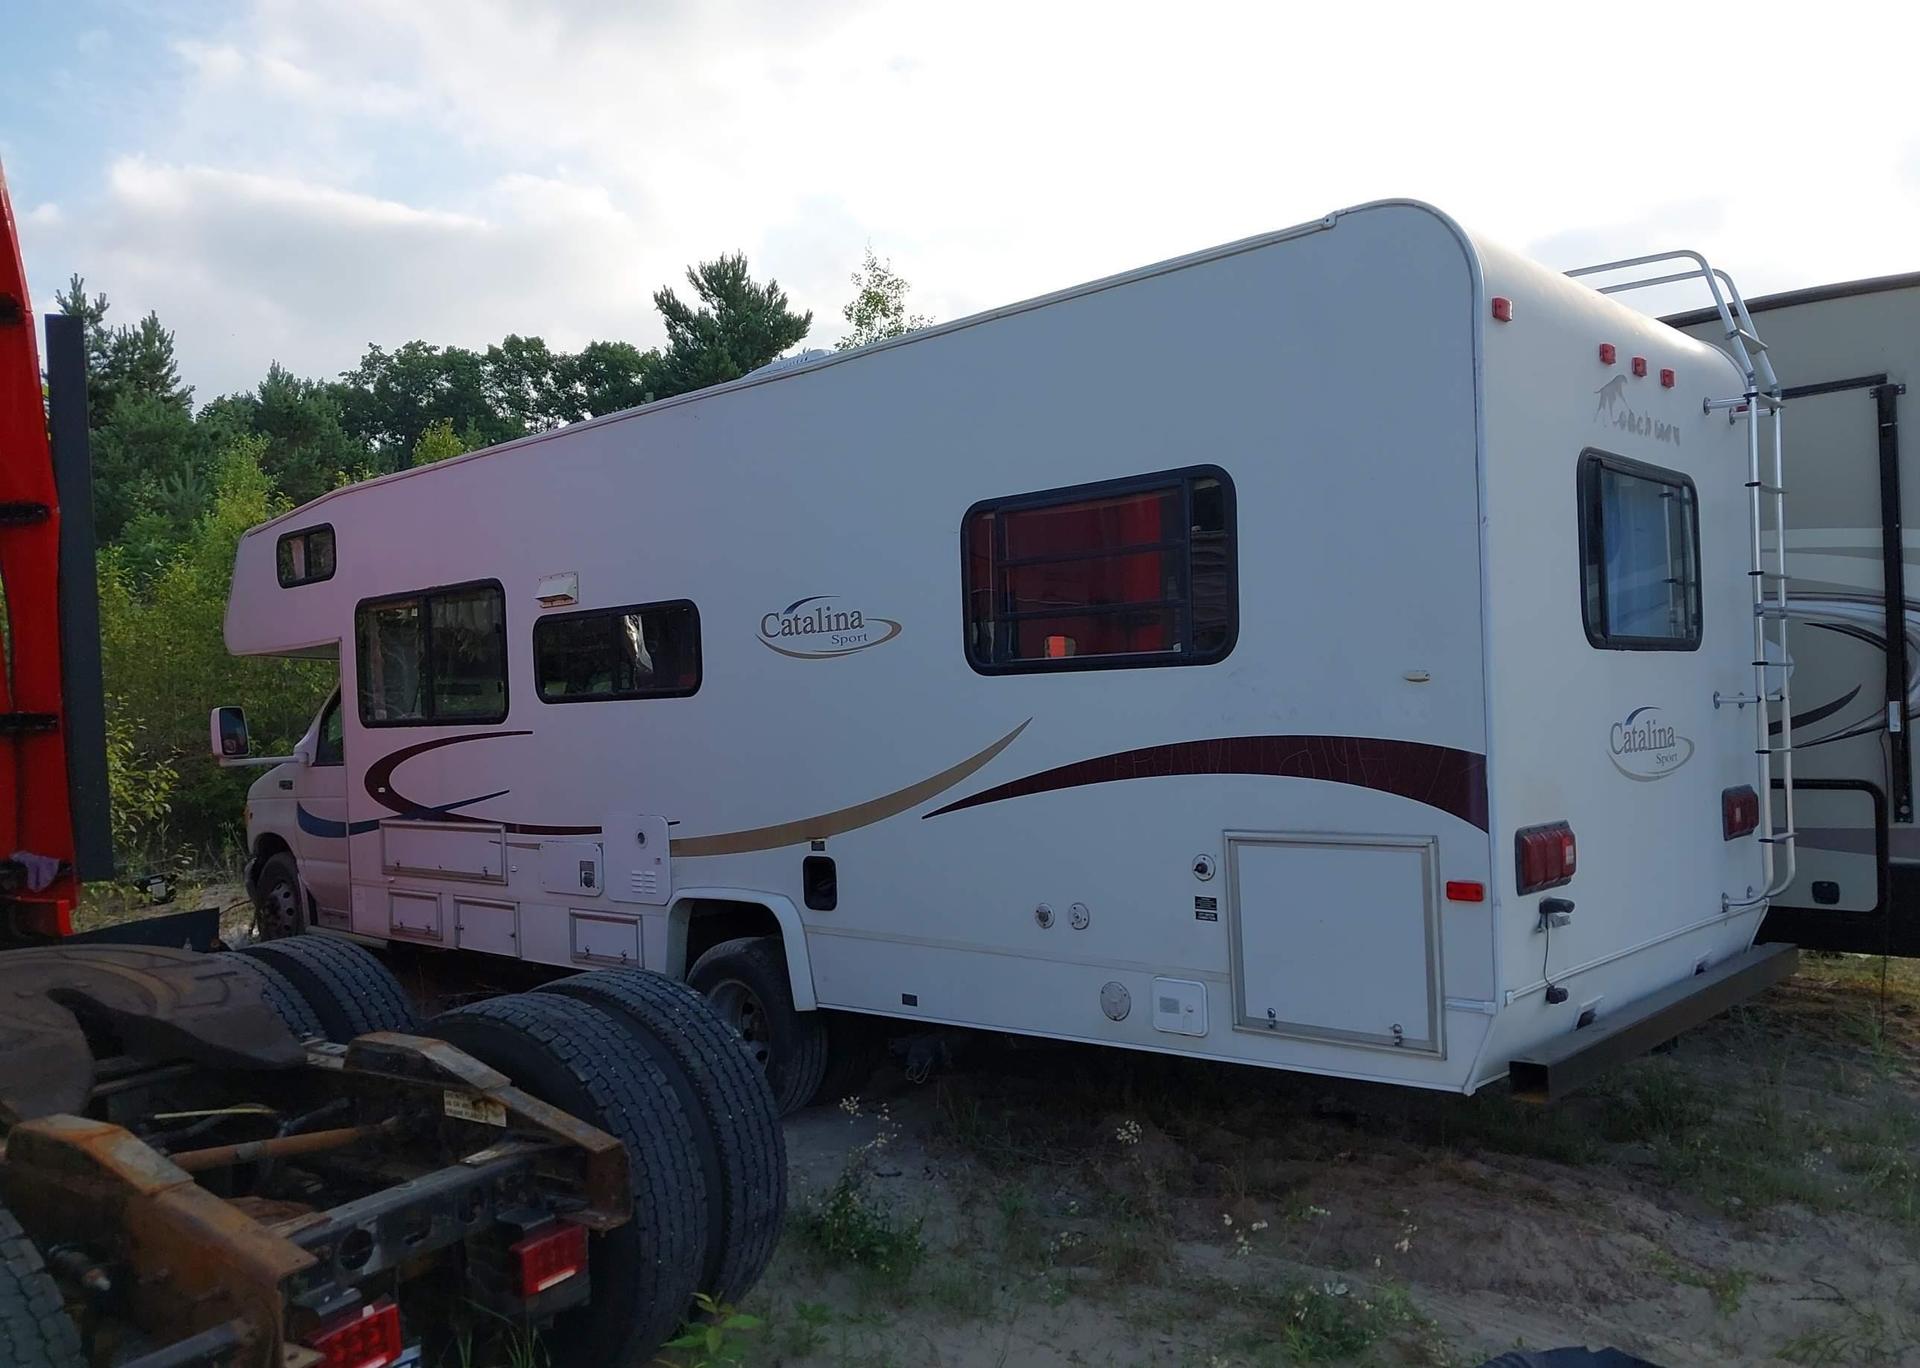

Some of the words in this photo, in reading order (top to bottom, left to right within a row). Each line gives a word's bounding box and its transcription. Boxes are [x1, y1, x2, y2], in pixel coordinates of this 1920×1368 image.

[761, 606, 865, 639] Catalina
[831, 633, 868, 646] Sport
[1610, 720, 1676, 755] Catalina
[1656, 753, 1678, 767] Sport
